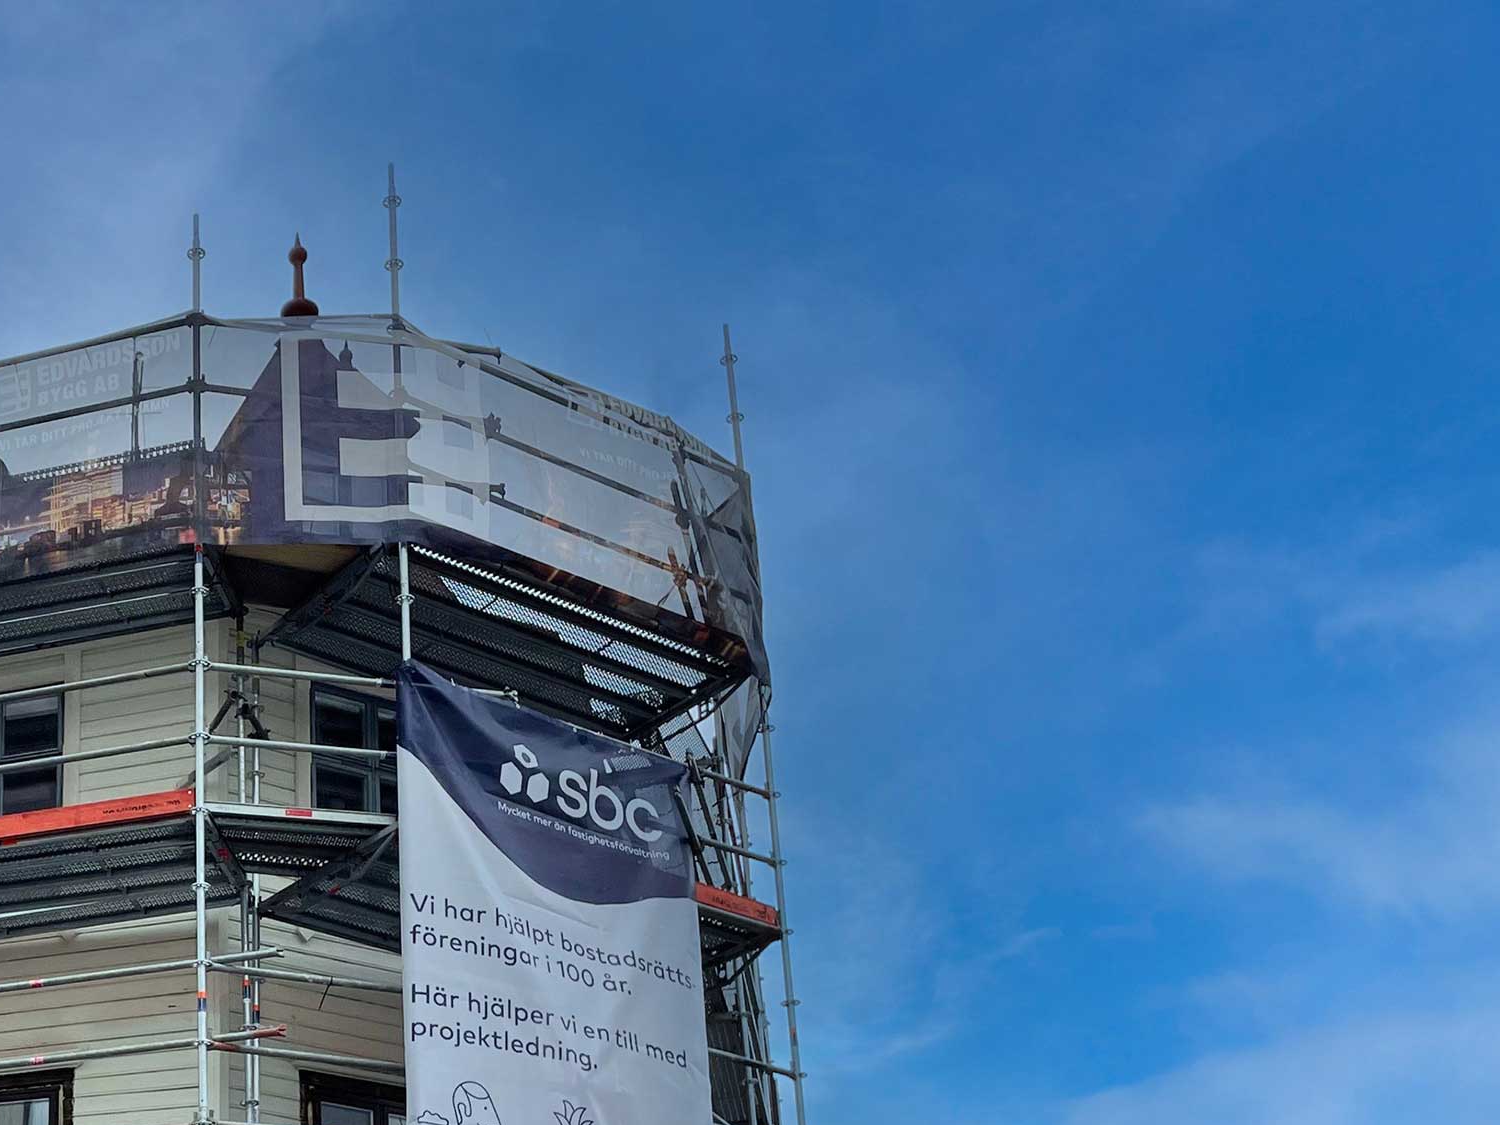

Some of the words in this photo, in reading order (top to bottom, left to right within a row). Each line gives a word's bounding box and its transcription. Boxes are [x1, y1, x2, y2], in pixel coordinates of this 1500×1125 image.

[498, 801, 532, 820] Mycket
[534, 815, 552, 827] mer
[554, 819, 566, 832] än
[568, 826, 670, 860] fastighetsförvaltning
[556, 768, 663, 842] sbc
[409, 893, 435, 914] Vi
[445, 898, 487, 924] har
[495, 907, 555, 946] hjälpt
[409, 924, 539, 968] föreningar
[545, 956, 552, 974] i
[557, 961, 595, 988] 100
[603, 973, 633, 996] år.
[411, 984, 460, 1009] Här
[468, 992, 554, 1027] hjälper
[561, 1016, 577, 1034] vi
[584, 1024, 610, 1042] en
[615, 1030, 639, 1053] till
[646, 1043, 687, 1069] med
[411, 1021, 598, 1071] projektledning.
